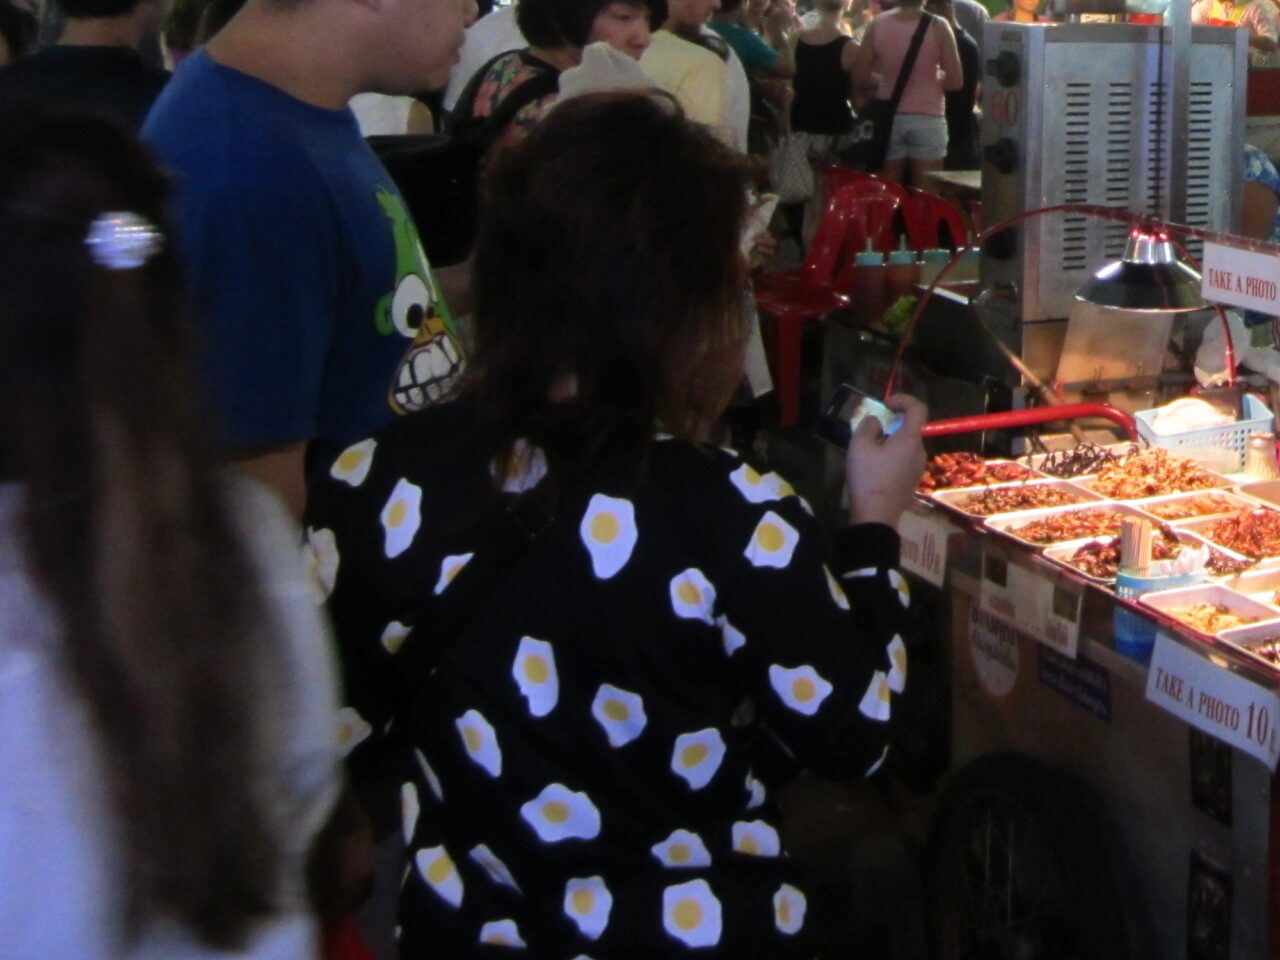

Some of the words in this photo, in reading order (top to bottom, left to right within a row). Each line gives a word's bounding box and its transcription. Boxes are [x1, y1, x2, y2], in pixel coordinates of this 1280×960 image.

[1208, 268, 1233, 291] TAKE
[1235, 275, 1243, 294] A
[1246, 276, 1277, 302] PHOTO
[1155, 667, 1185, 703] TAKE
[1186, 686, 1194, 710] A
[1198, 692, 1241, 731] PHOTO
[1246, 701, 1269, 746] 10
